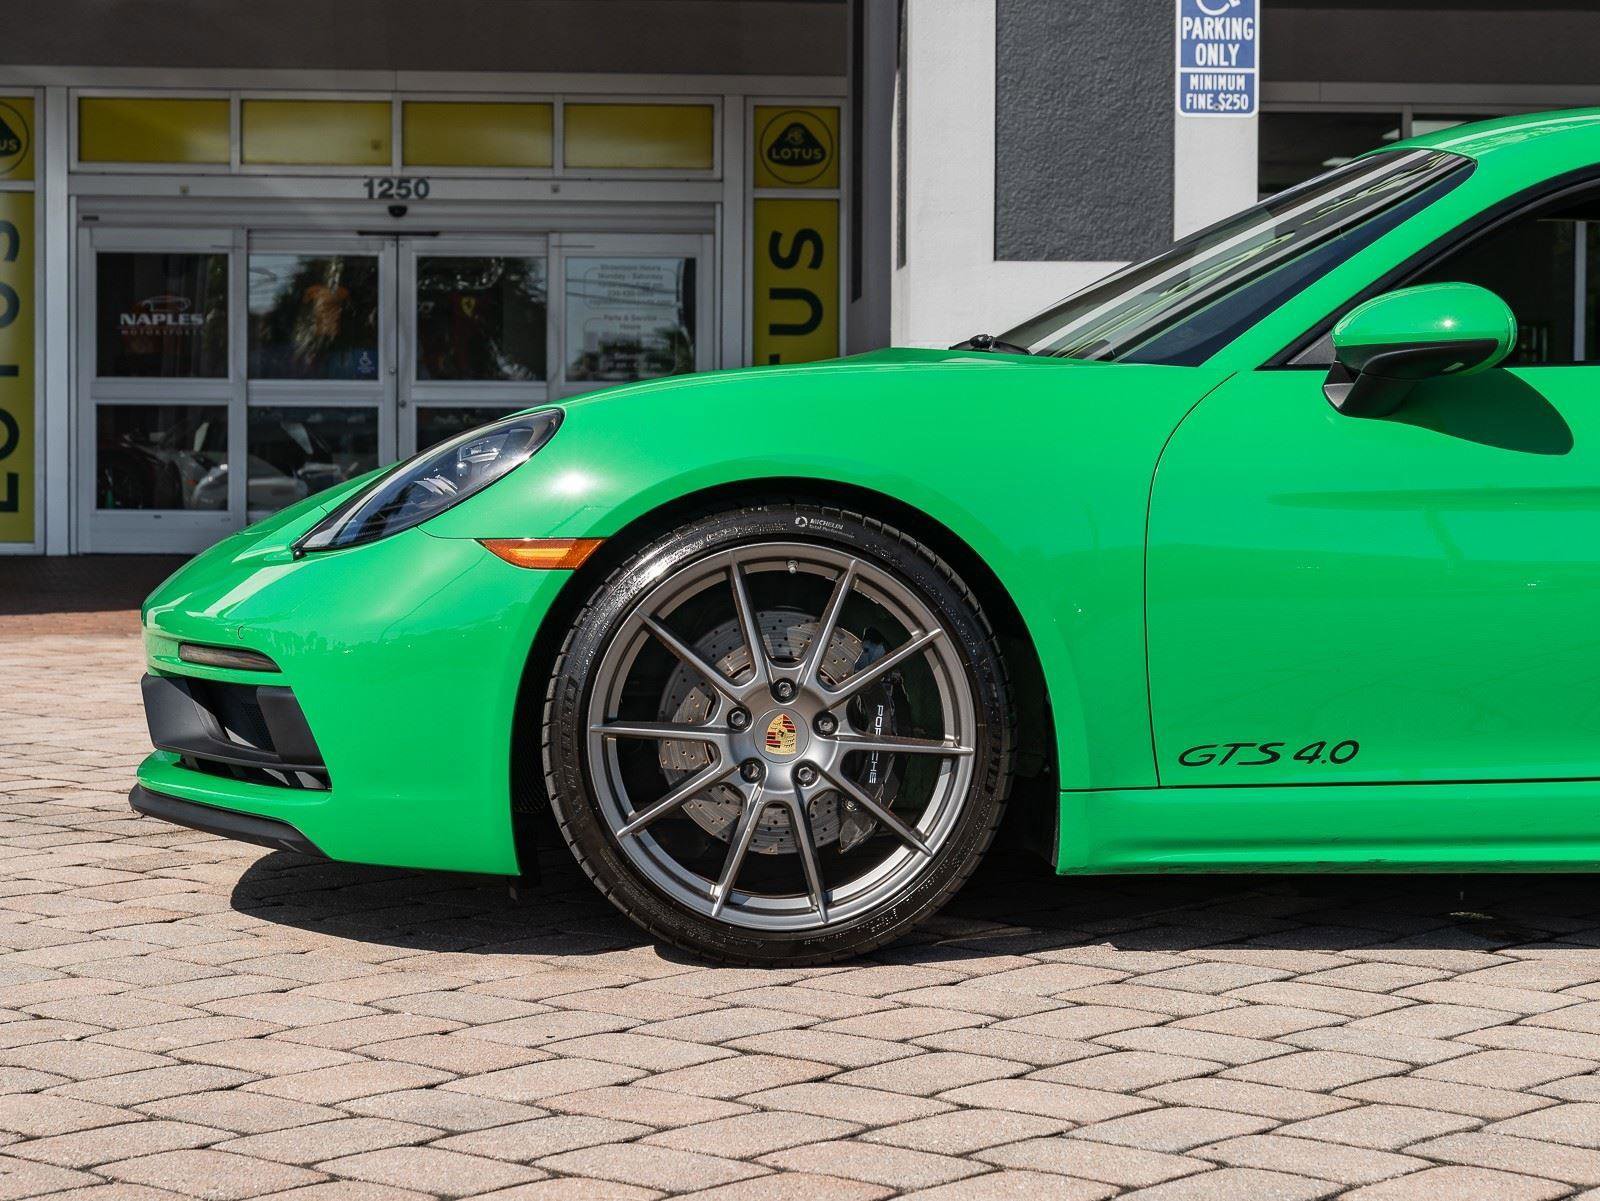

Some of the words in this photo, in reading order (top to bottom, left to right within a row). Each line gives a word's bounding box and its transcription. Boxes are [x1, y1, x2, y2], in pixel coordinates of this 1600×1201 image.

[1182, 17, 1254, 40] PARKING
[1195, 43, 1240, 66] ONLY
[1189, 74, 1245, 91] MINIMUM
[1185, 93, 1214, 110] FINE
[1218, 92, 1249, 111] $250
[771, 148, 822, 160] LOTUS
[363, 177, 430, 200] 1250
[769, 228, 824, 366] US
[120, 312, 204, 325] NAPLES
[809, 518, 844, 530] MICHELIN
[869, 704, 884, 784] PORCHE
[1178, 742, 1286, 767] GTS
[1293, 739, 1360, 765] 4.0
